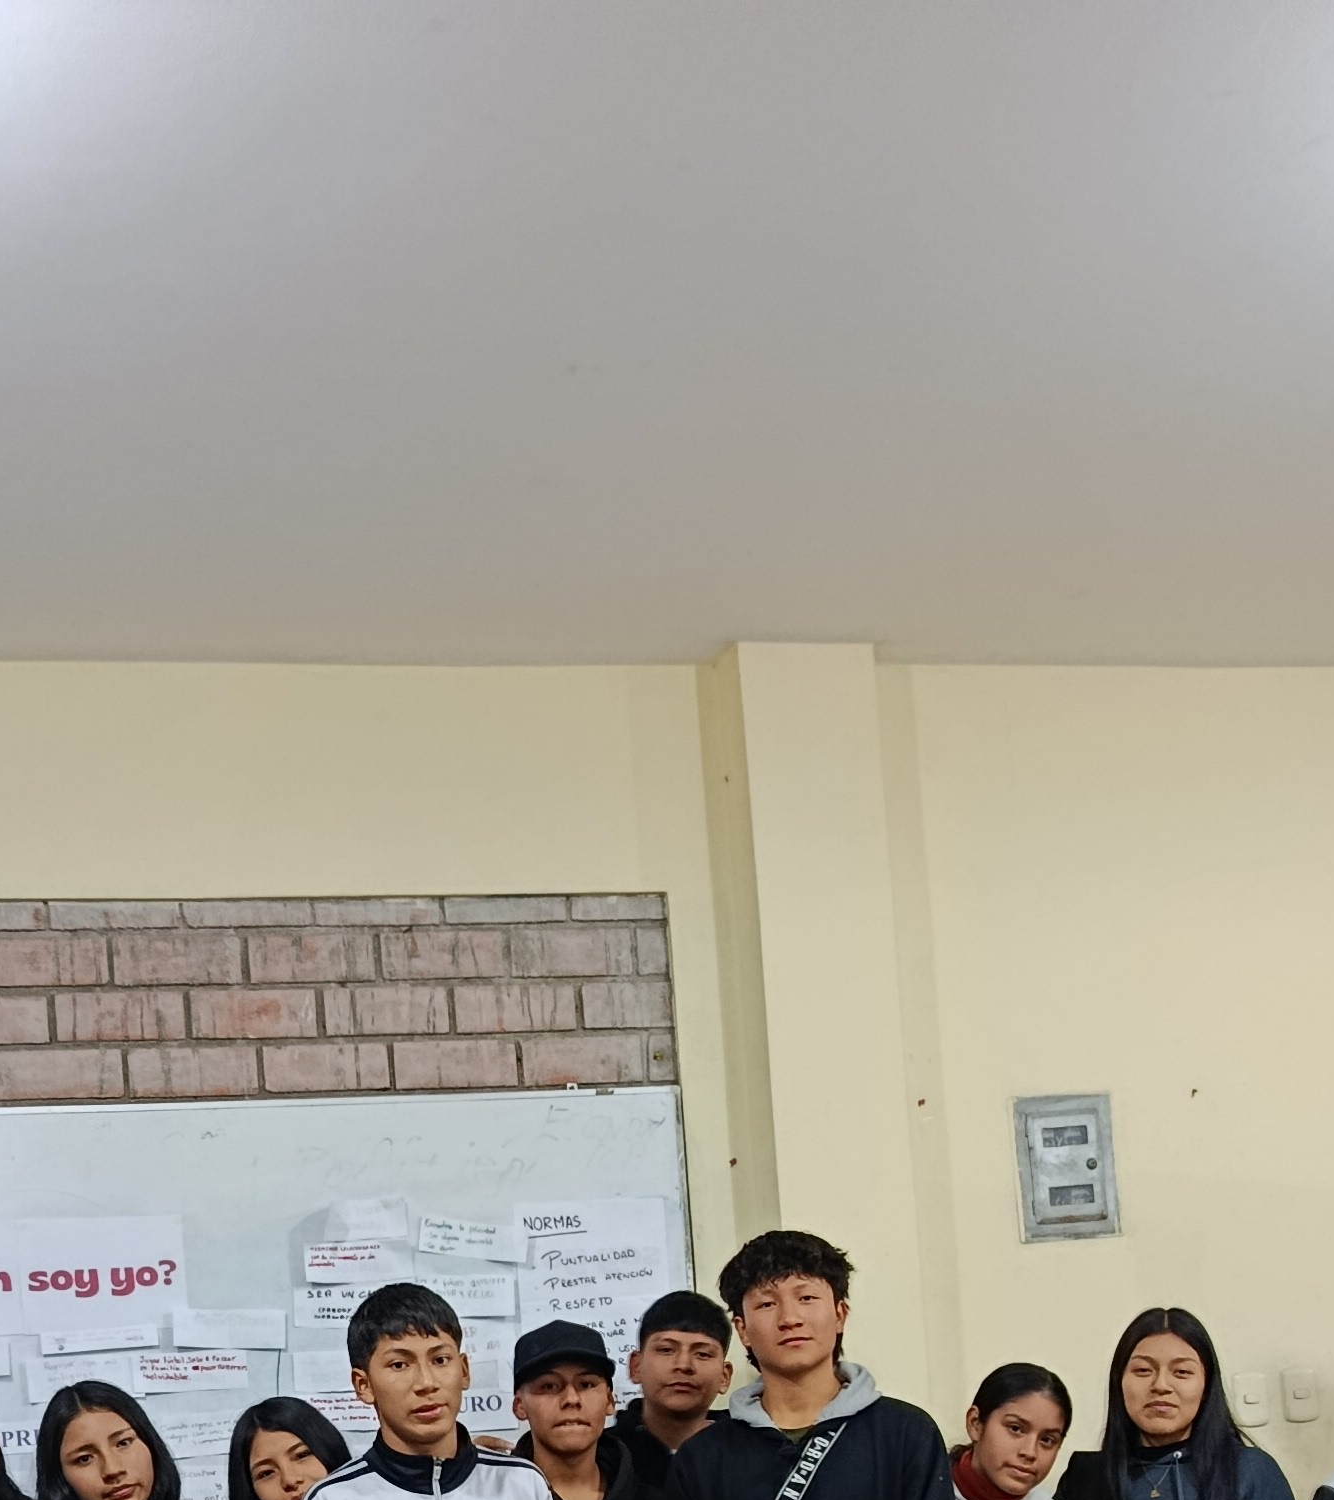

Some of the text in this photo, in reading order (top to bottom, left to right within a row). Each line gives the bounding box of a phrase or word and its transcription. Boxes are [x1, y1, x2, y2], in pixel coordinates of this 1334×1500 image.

[523, 1215, 582, 1231] NORMAS
[540, 1248, 636, 1270] PUNTUALIDAD
[28, 1268, 100, 1298] soy
[110, 1259, 177, 1297] yo?
[543, 1276, 597, 1290] PRESTAR
[549, 1296, 613, 1312] RESPETO
[783, 1431, 836, 1500] ORDAN
